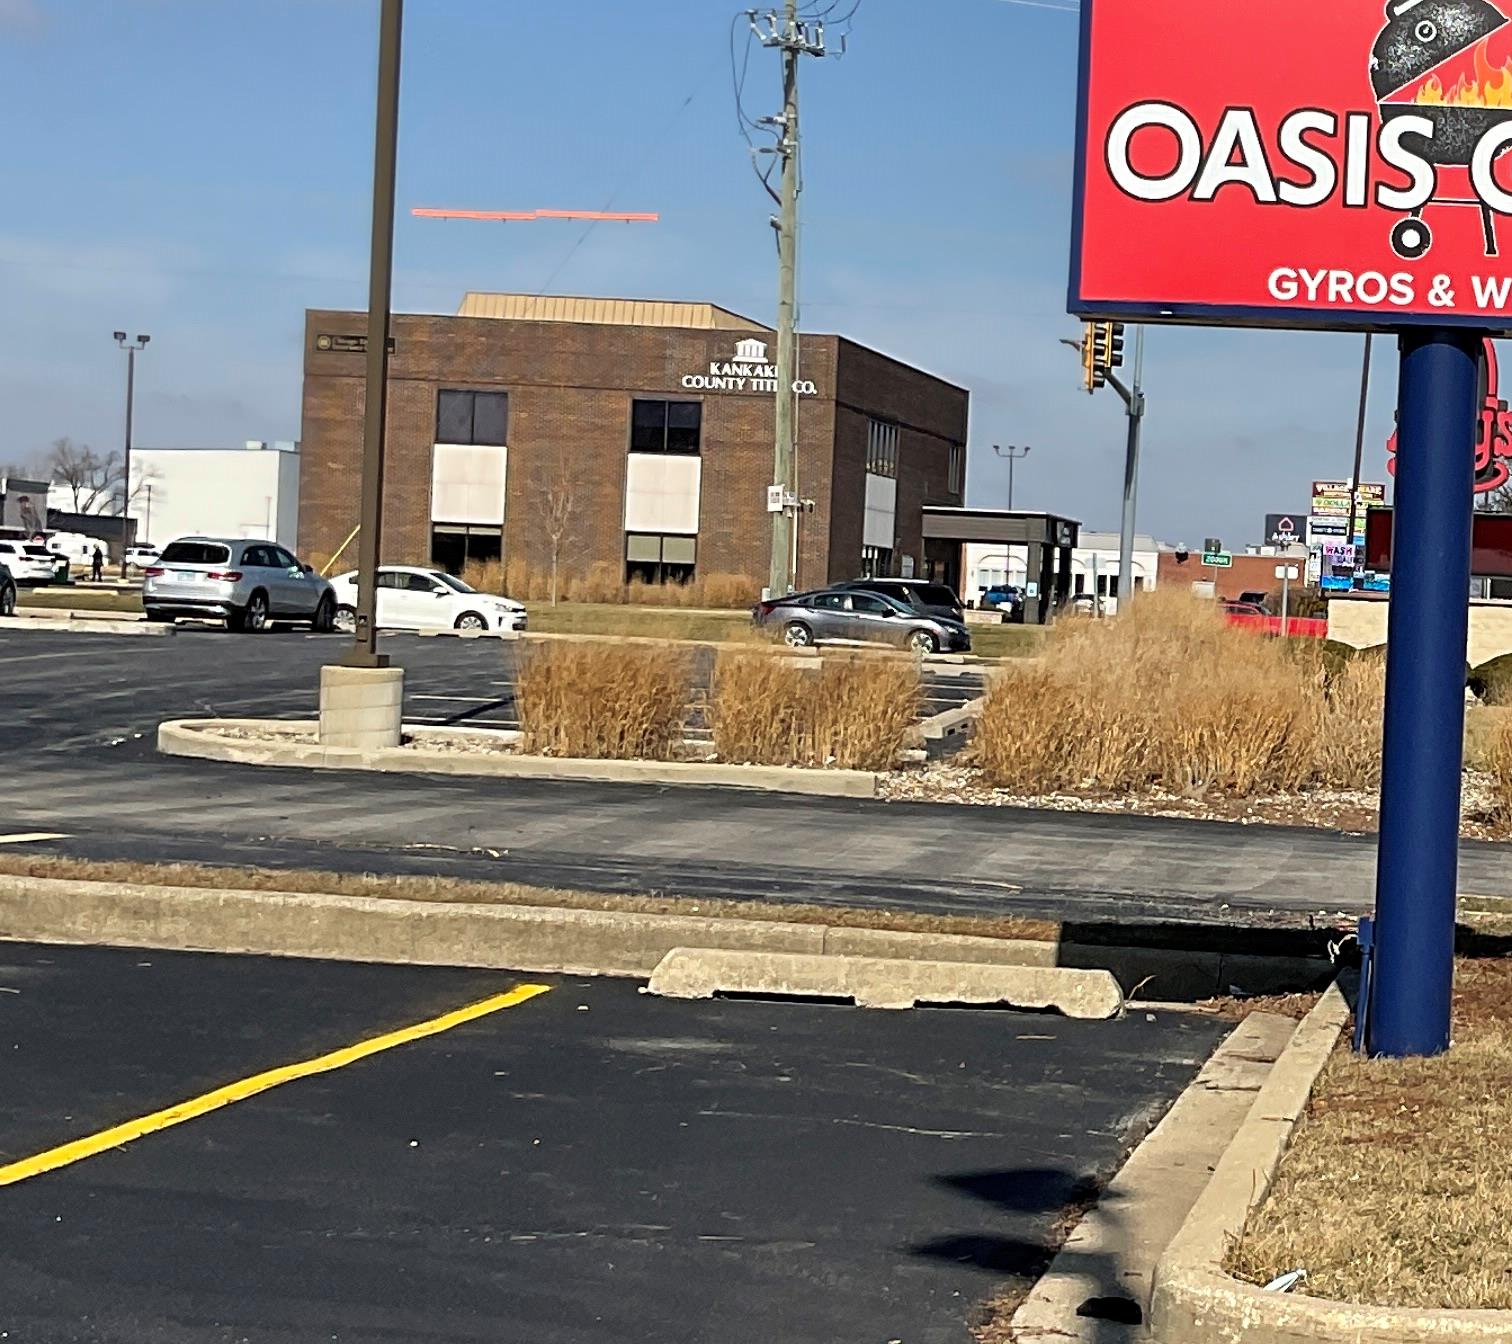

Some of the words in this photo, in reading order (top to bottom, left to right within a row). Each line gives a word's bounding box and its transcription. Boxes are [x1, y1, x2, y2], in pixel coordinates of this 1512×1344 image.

[1104, 100, 1435, 212] OASIS
[1267, 267, 1415, 307] GYROS
[1430, 274, 1456, 309] &
[681, 375, 746, 391] COUNTY
[791, 380, 818, 394] CO.
[709, 362, 778, 377] KANKAK
